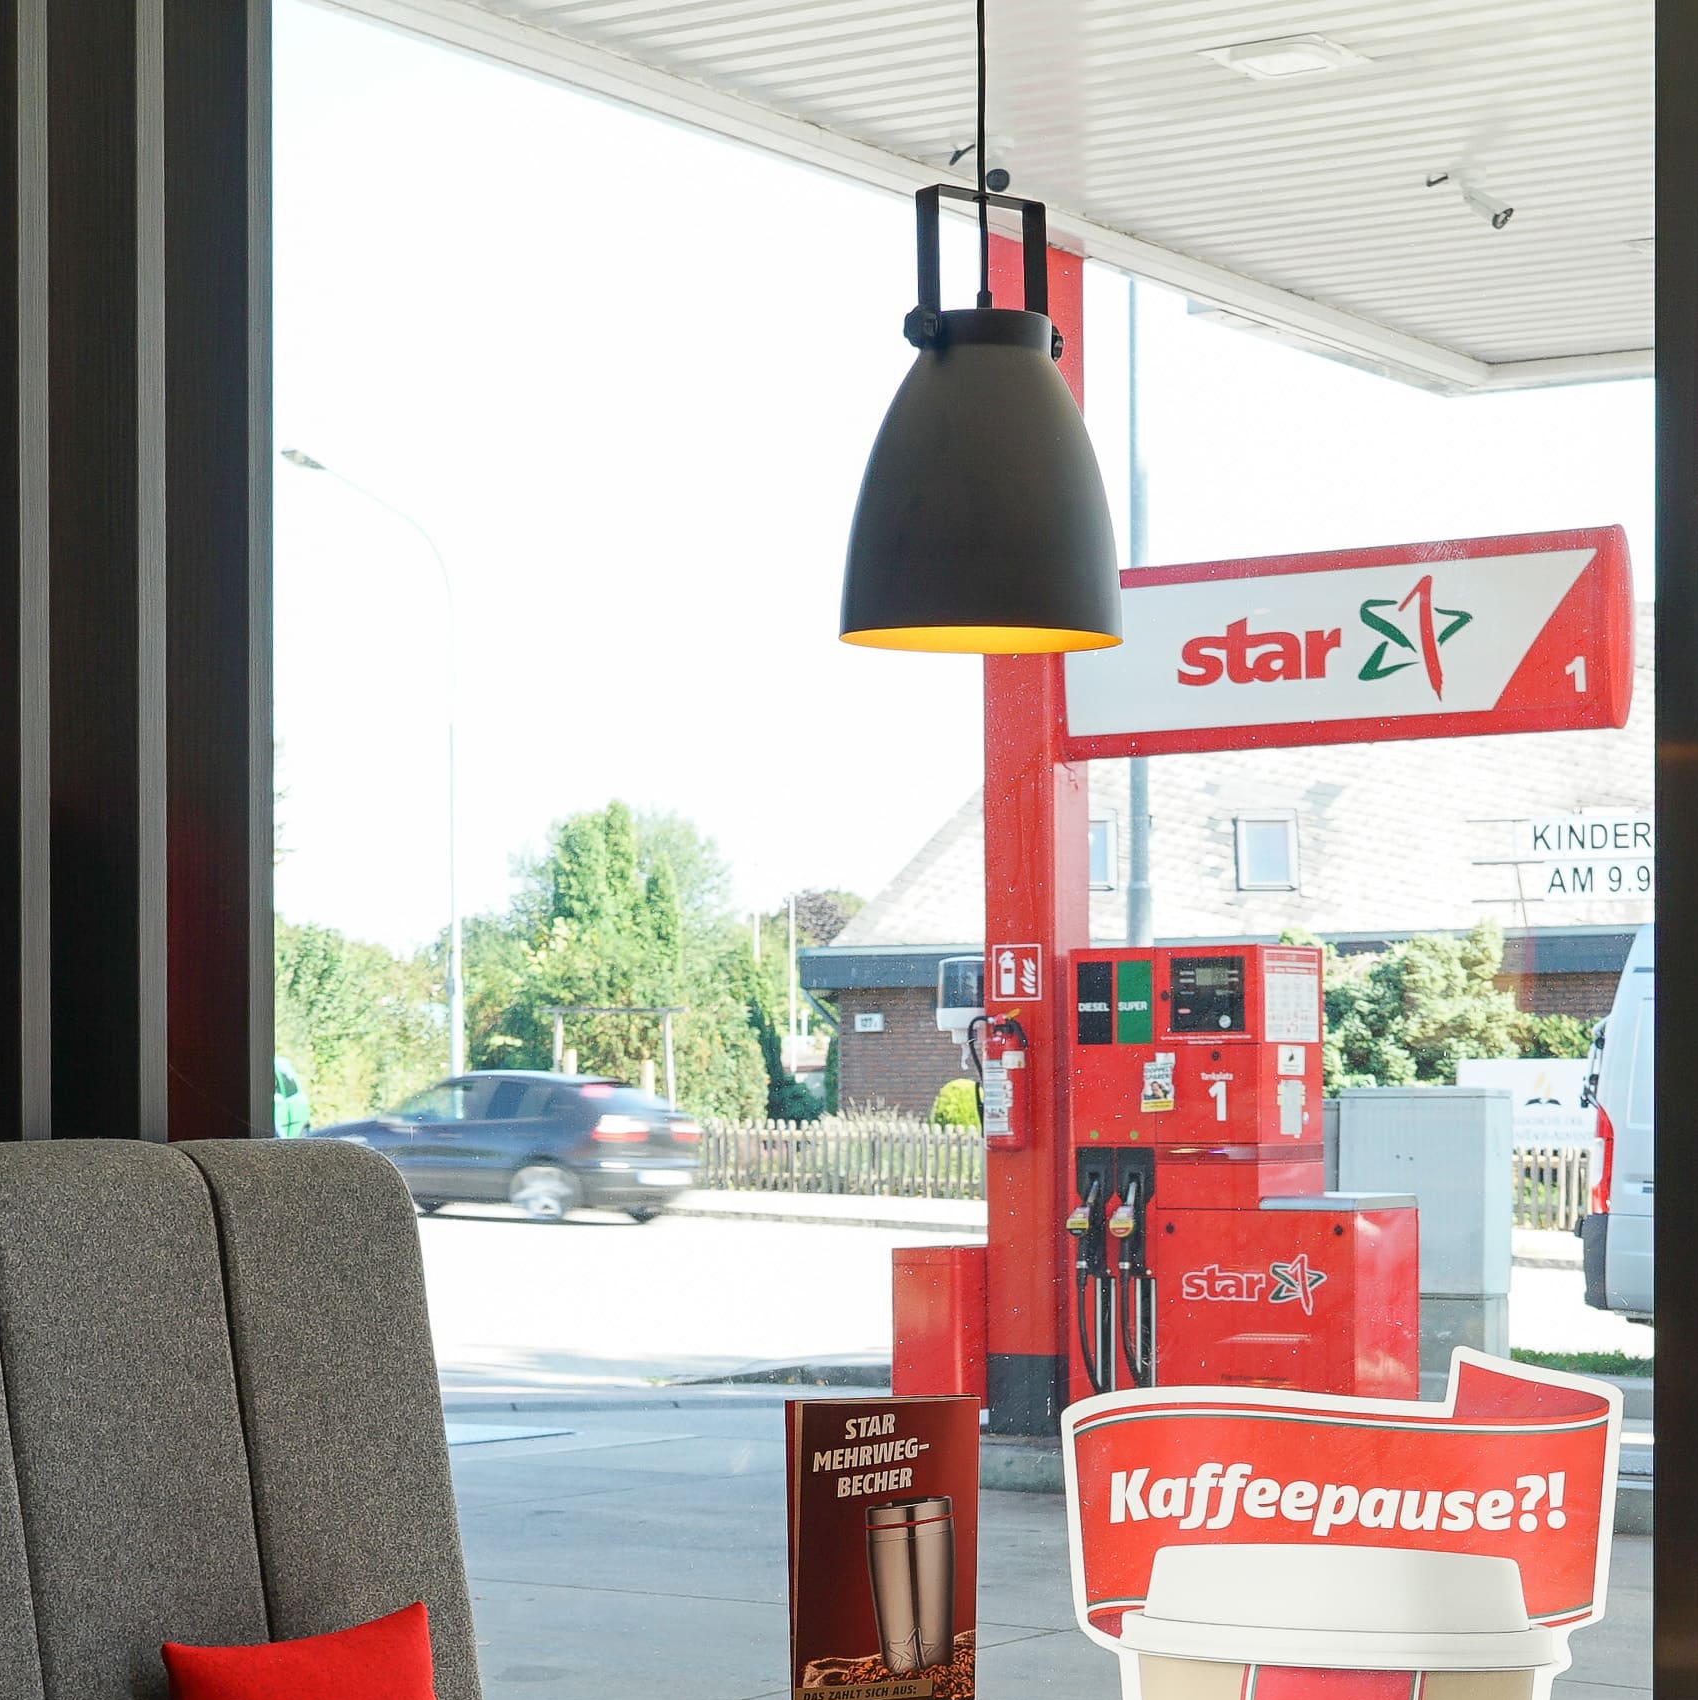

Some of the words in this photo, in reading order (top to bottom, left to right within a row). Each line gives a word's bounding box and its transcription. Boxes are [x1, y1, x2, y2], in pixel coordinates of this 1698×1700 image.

[1177, 618, 1342, 687] star
[1564, 655, 1588, 693] 1
[1548, 866, 1594, 894] AM
[1078, 1002, 1111, 1013] DIESEL
[1117, 1001, 1147, 1011] SUPER
[1208, 1080, 1227, 1121] 1
[1182, 1264, 1266, 1302] star
[845, 1413, 896, 1440] STAR
[812, 1437, 930, 1473] MEHRWEG-
[837, 1467, 913, 1498] BECHER
[1109, 1462, 1568, 1537] Kaffeepause?!
[829, 1688, 863, 1700] ZAHLT
[865, 1686, 889, 1698] SICH
[892, 1684, 917, 1696] AUS:
